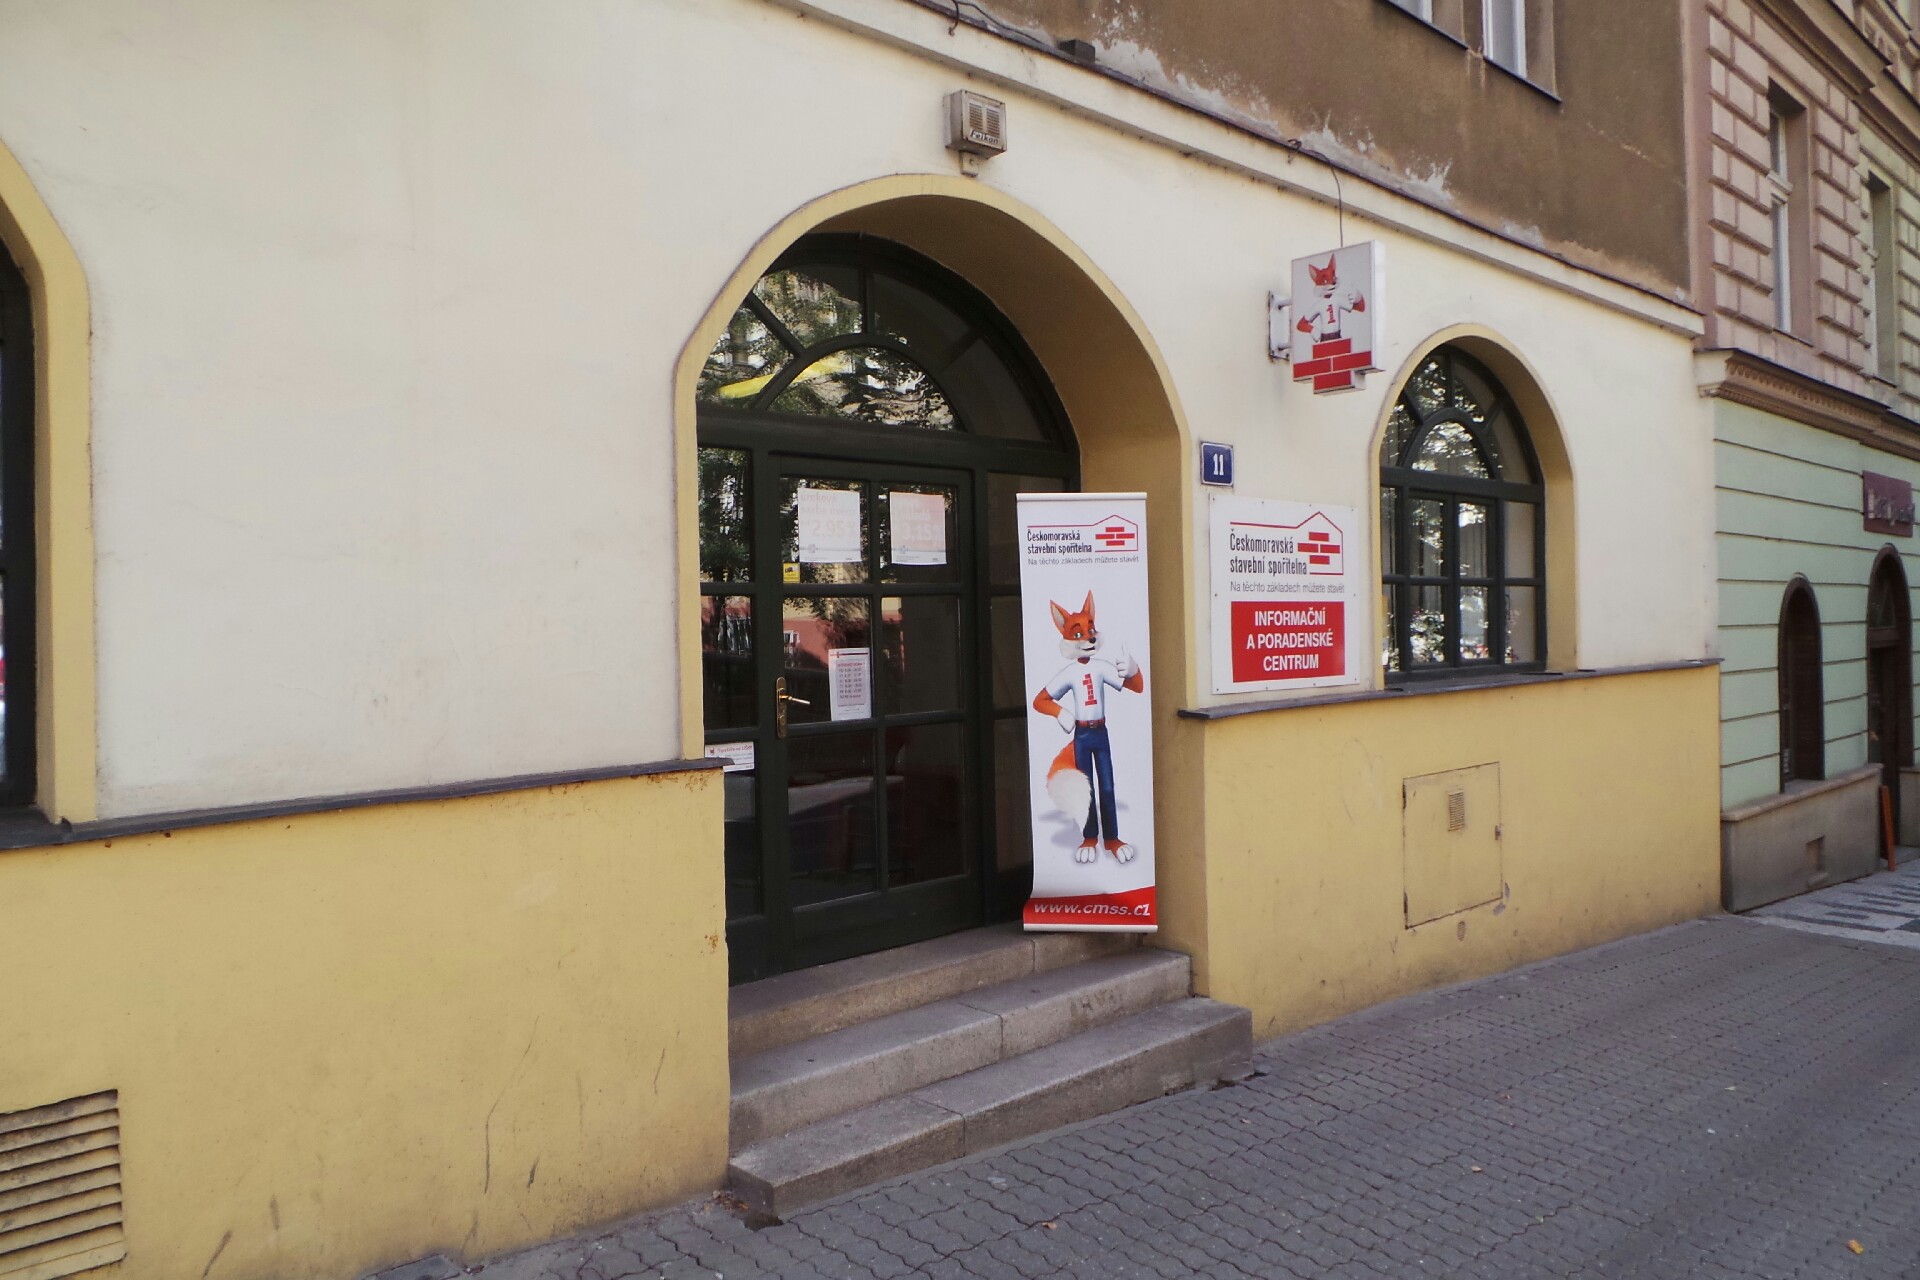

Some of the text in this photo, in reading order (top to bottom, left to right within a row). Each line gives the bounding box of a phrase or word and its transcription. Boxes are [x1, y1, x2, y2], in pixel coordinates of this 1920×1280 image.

[1212, 453, 1224, 476] 11
[1027, 529, 1080, 542] Českomoravská
[1230, 528, 1294, 554] Českomoravská
[1028, 542, 1092, 555] stavební spořitelna
[1039, 557, 1060, 565] těchto
[1061, 556, 1093, 564] základech
[1094, 556, 1118, 564] můžete
[1230, 556, 1308, 577] stavební spořitelna
[1230, 581, 1345, 594] Na těchto základech můžete stavět
[1254, 607, 1326, 626] INFORMAČNÍ
[1246, 628, 1334, 650] A PORADENSKÉ
[1263, 654, 1319, 672] CENTRUM
[1082, 673, 1098, 706] 1
